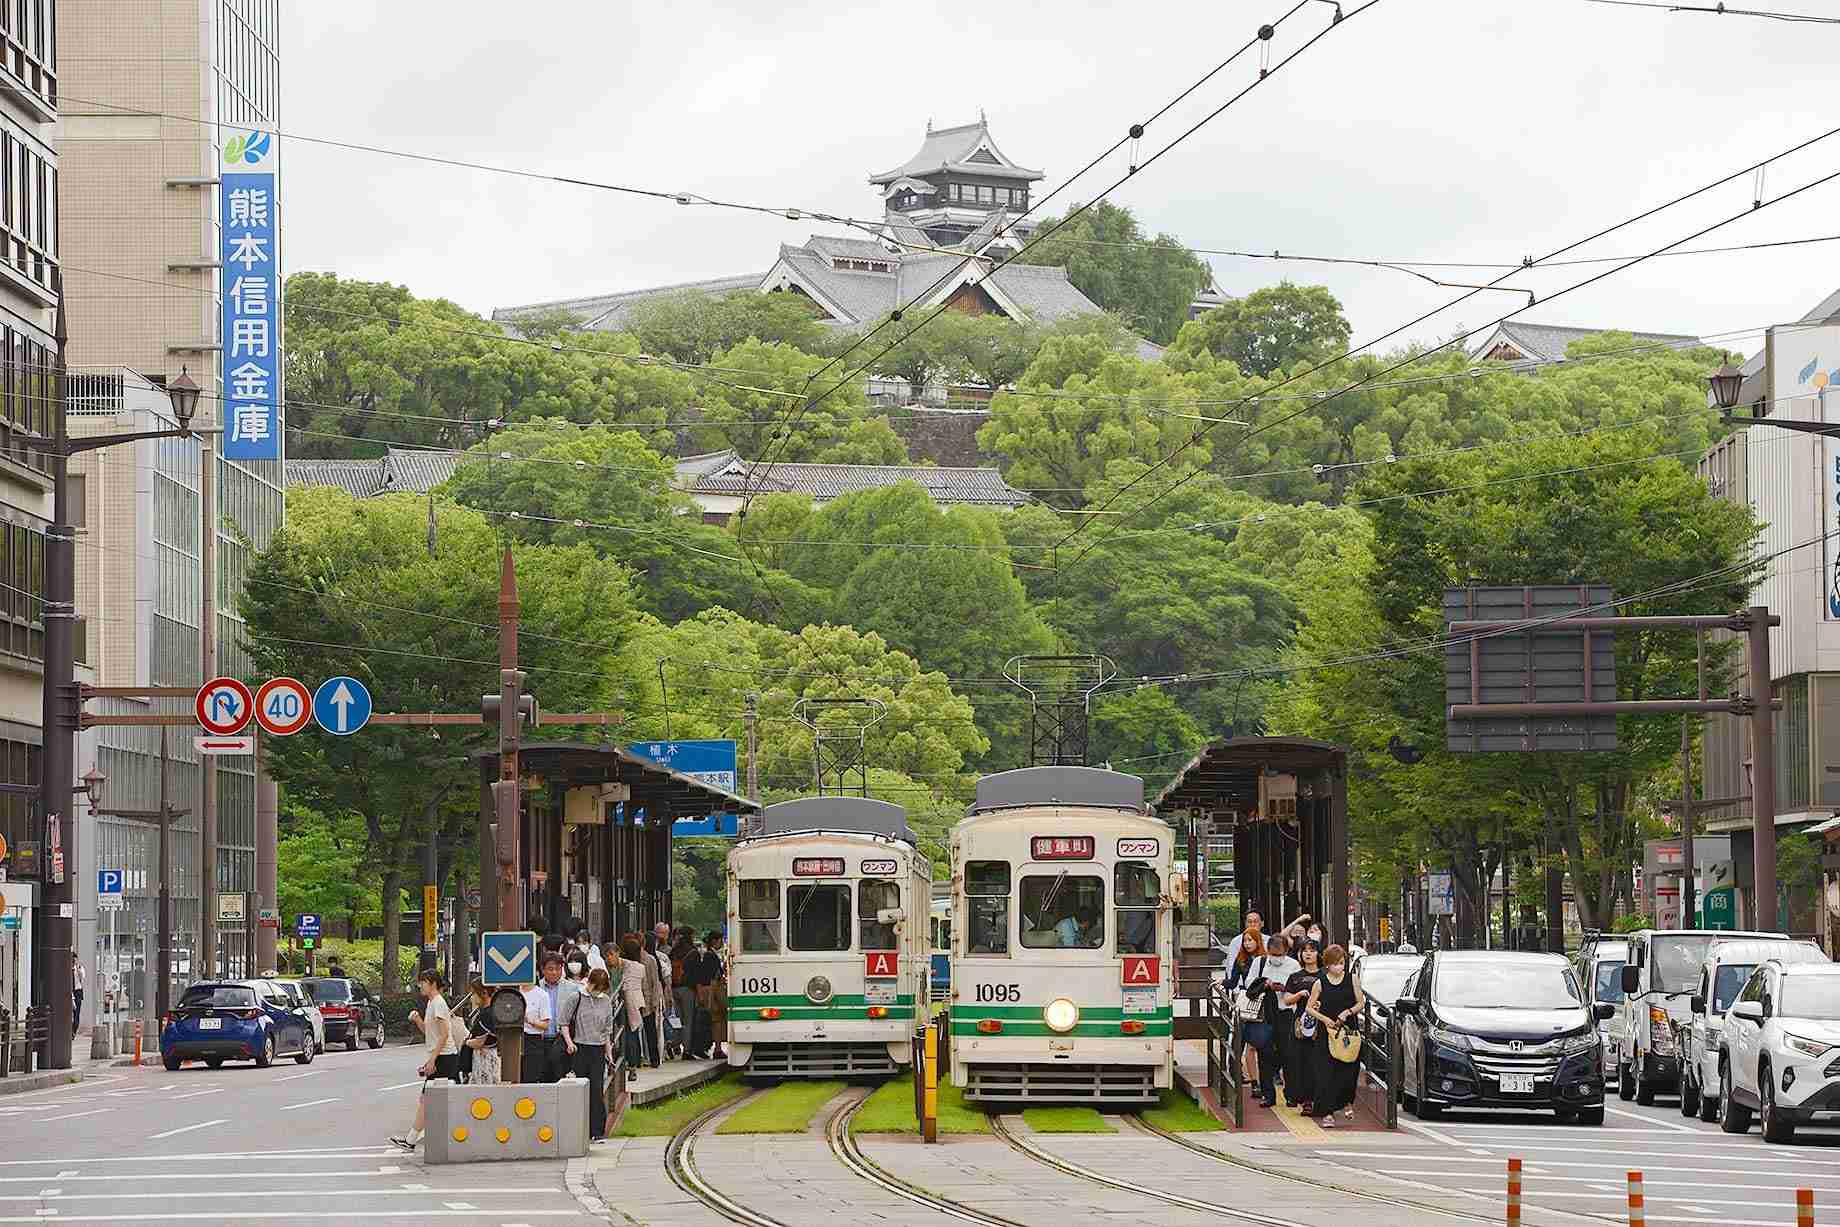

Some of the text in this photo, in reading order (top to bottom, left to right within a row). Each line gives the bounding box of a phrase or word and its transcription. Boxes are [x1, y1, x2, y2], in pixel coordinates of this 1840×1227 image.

[229, 188, 270, 443] 熊本信用金庫
[268, 694, 298, 718] 40
[1120, 843, 1156, 853] ワンマン
[863, 863, 896, 871] ワンマン
[104, 872, 117, 891] P
[303, 915, 315, 926] P
[875, 954, 889, 973] A
[1132, 960, 1150, 980] A
[741, 977, 779, 993] 1081
[975, 984, 1021, 1001] 1095
